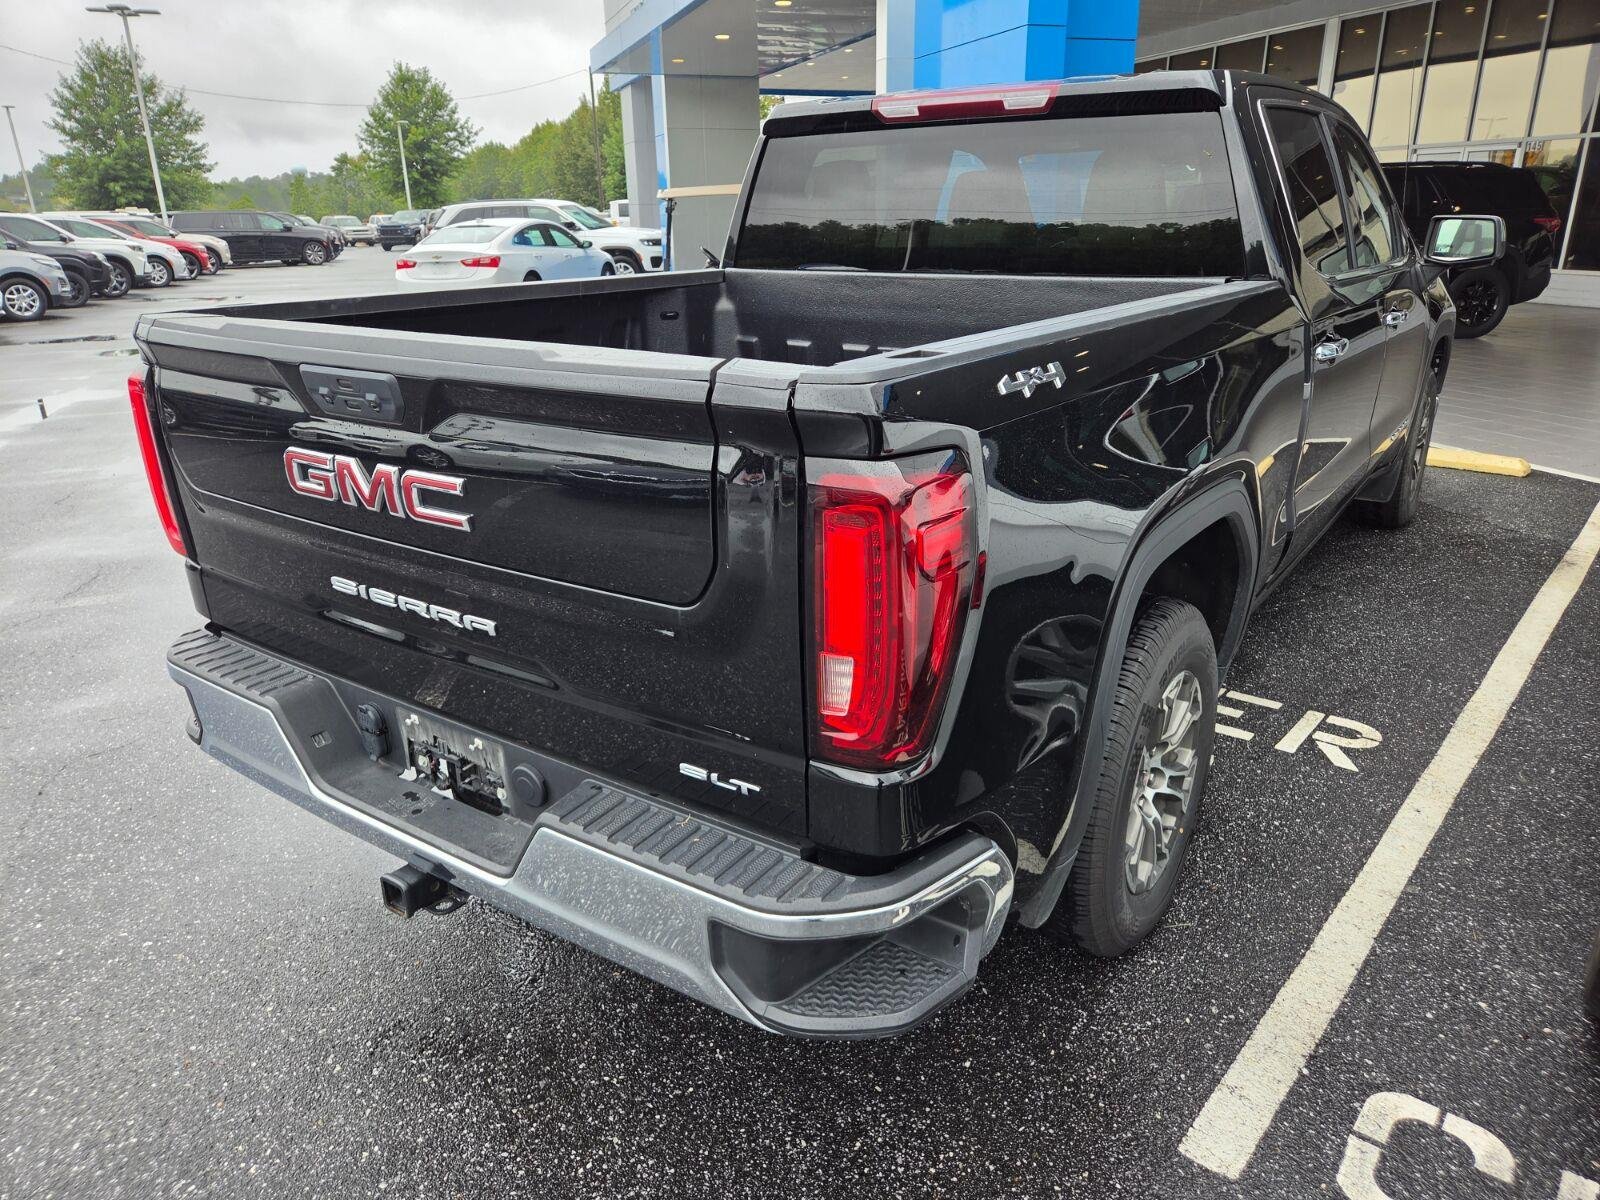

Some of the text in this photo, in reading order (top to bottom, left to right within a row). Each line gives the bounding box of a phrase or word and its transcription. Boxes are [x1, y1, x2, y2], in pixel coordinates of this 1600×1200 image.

[284, 446, 474, 532] GMC
[330, 576, 497, 636] SIERRA
[679, 763, 762, 796] SLT
